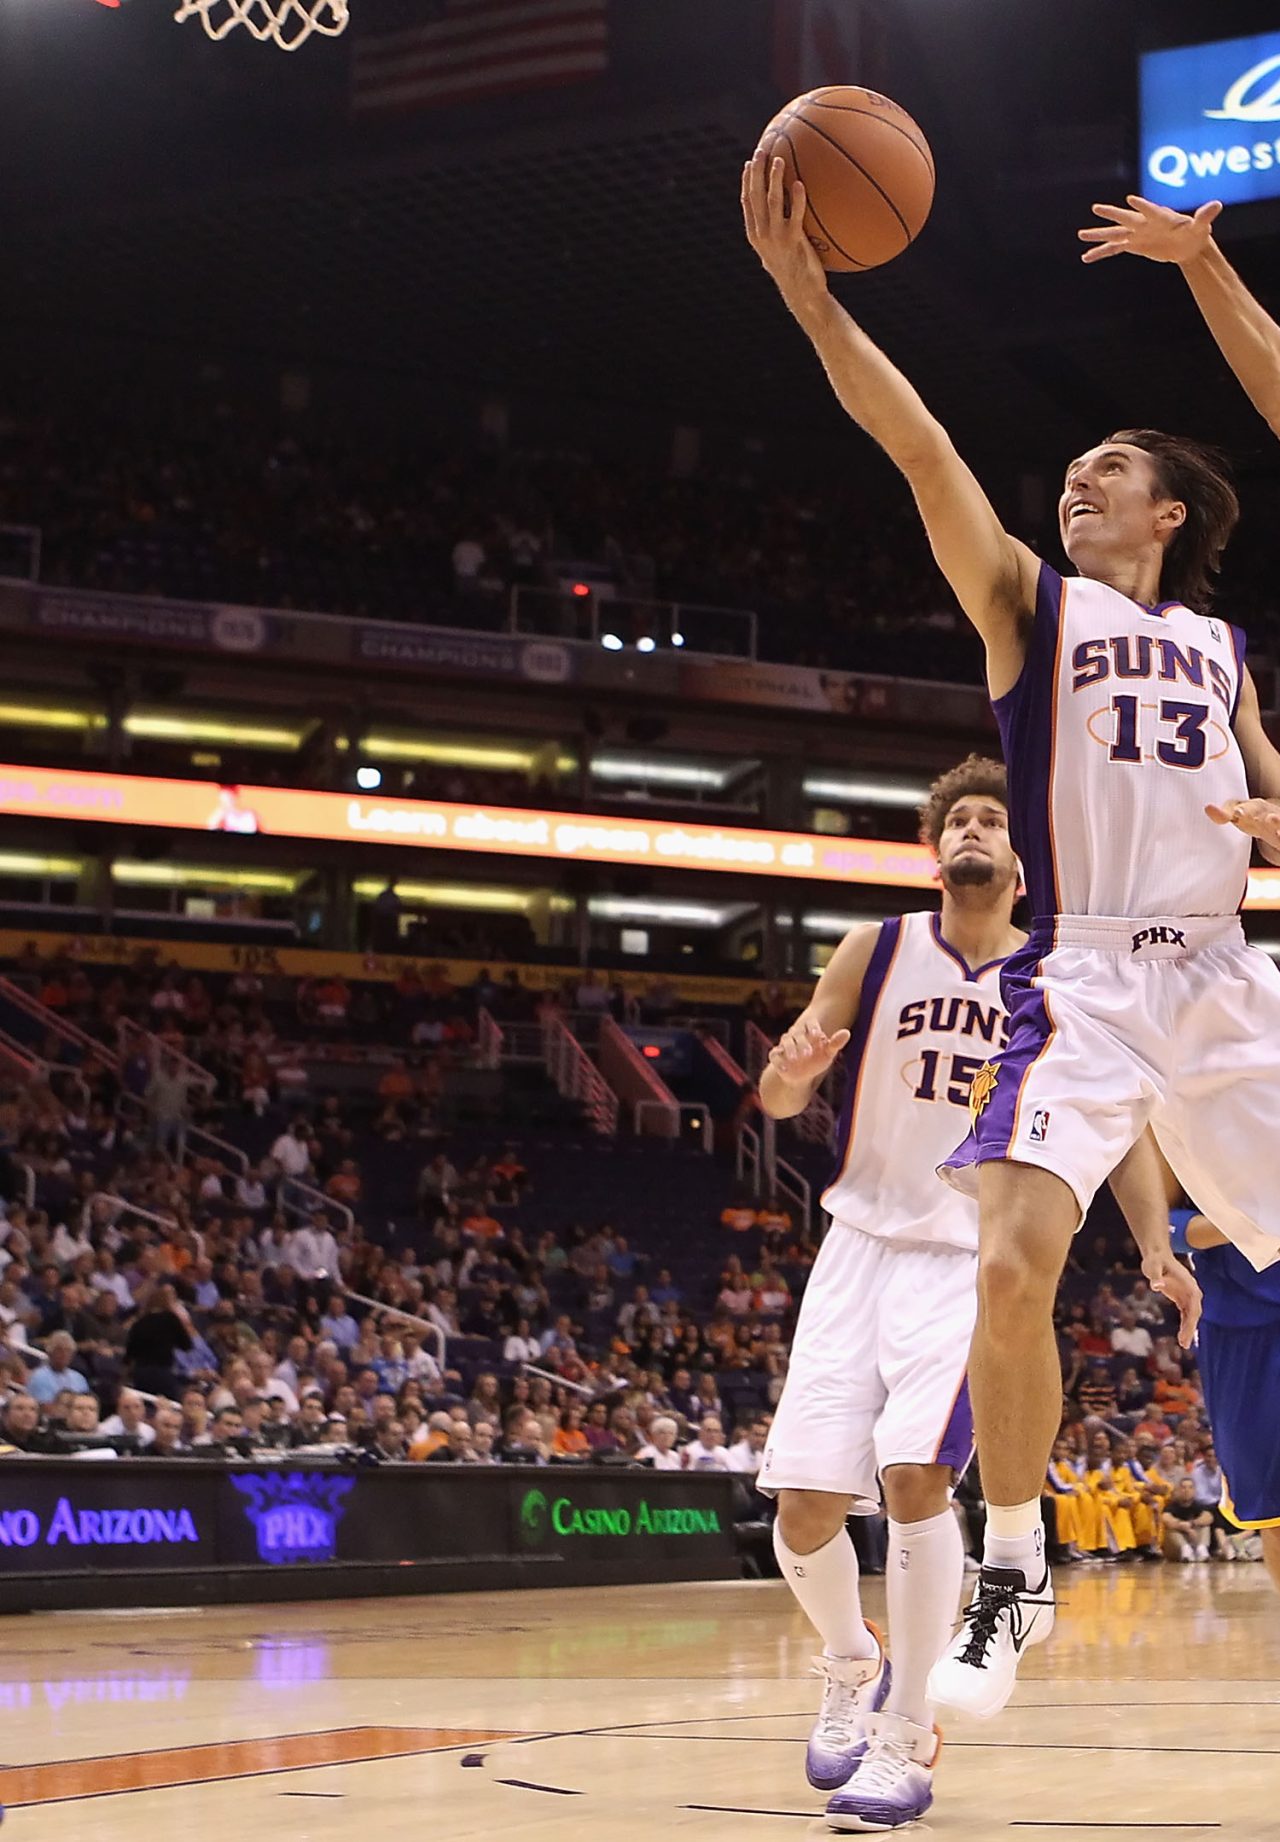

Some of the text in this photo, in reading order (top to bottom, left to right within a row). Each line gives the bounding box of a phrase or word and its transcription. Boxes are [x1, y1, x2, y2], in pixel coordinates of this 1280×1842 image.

[1071, 635, 1234, 705] SUNS
[1108, 694, 1209, 772] 13
[1131, 926, 1187, 953] PHX
[913, 1050, 987, 1109] 15
[46, 1497, 199, 1545] ARIZONA
[264, 1511, 331, 1549] PHX
[552, 1498, 721, 1535] CASINO ARIZONA
